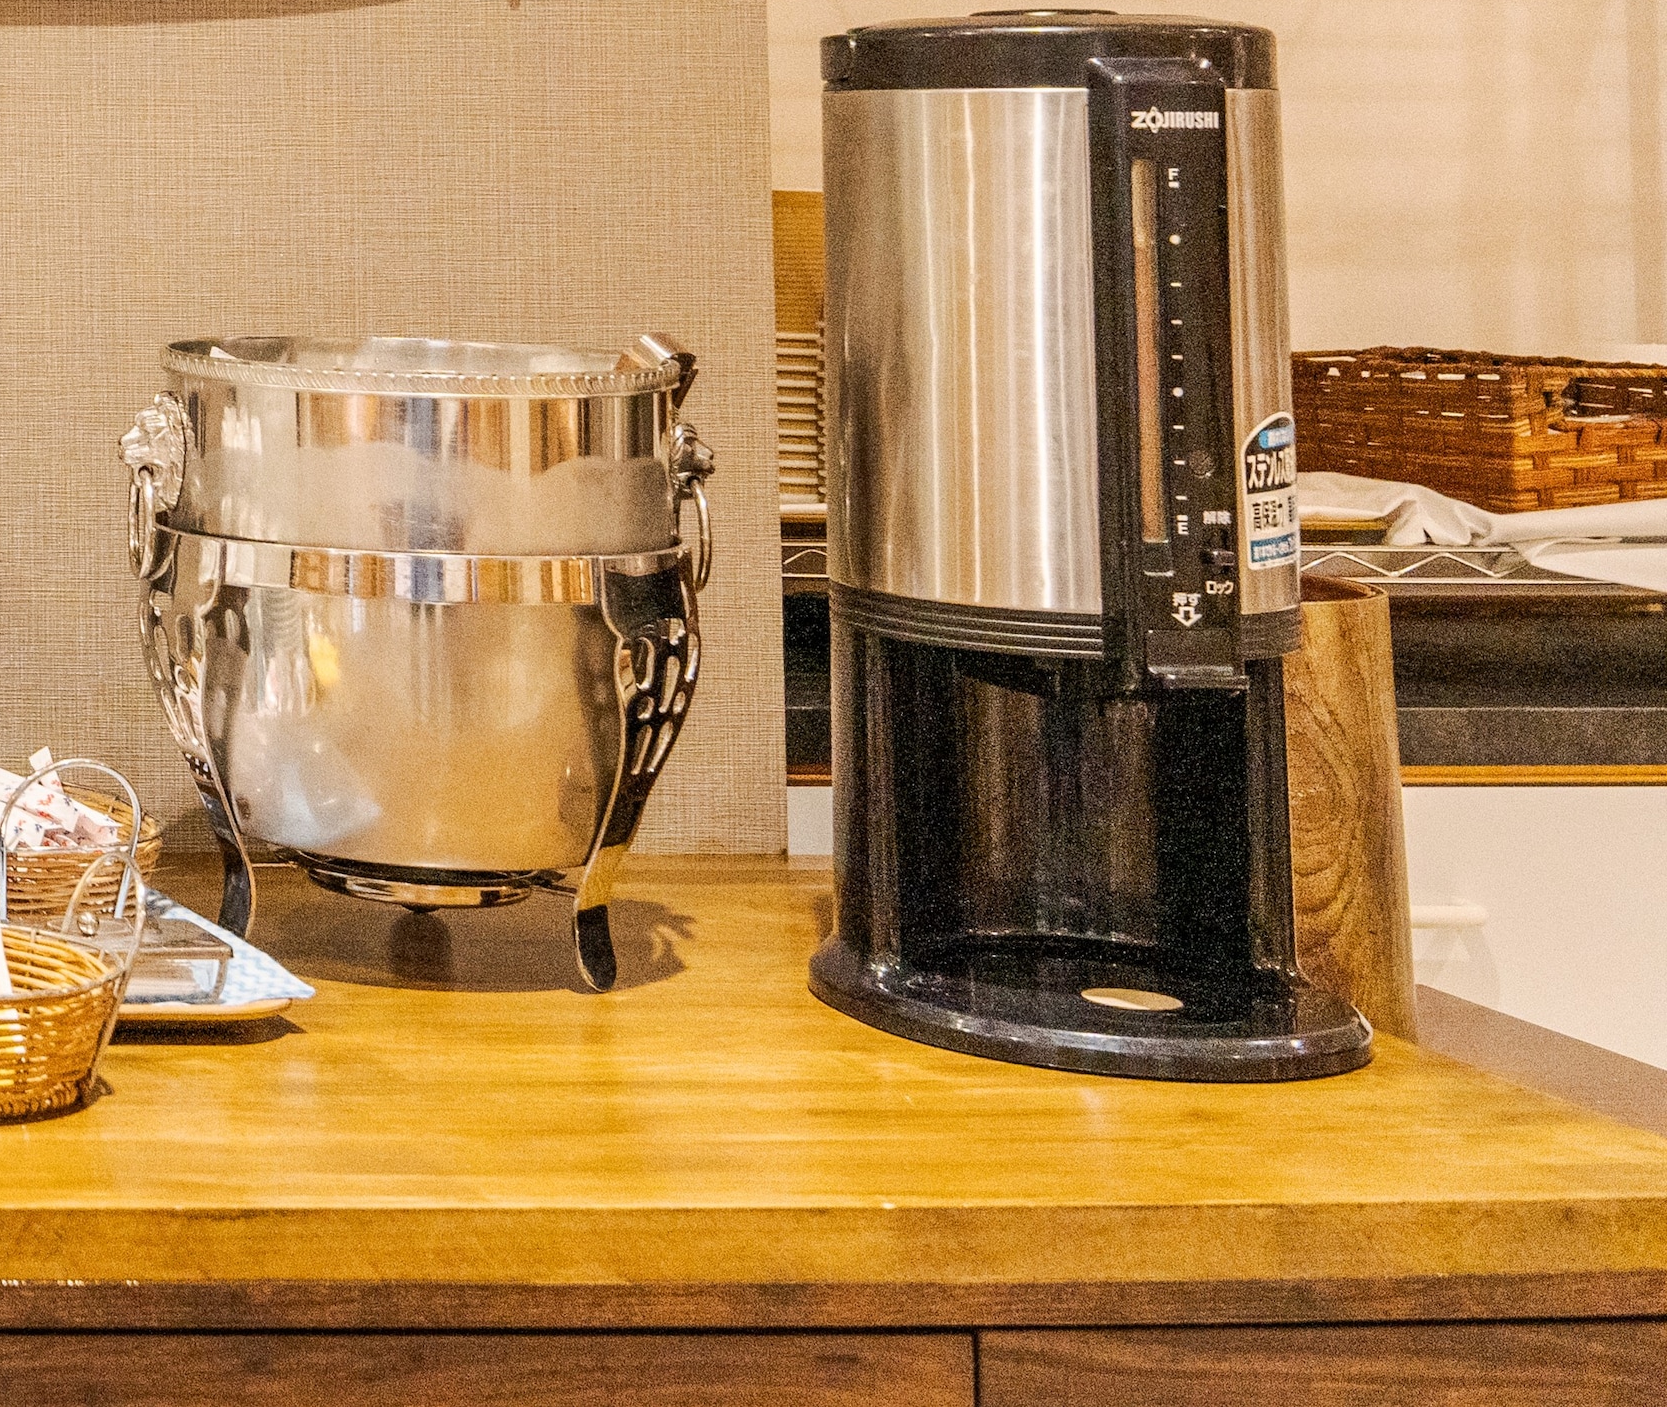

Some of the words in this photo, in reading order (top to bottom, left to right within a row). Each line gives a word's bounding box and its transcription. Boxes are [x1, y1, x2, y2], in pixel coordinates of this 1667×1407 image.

[1130, 105, 1220, 134] ZOJIRUSHI
[1168, 168, 1179, 181] F
[1177, 522, 1188, 535] E
[1205, 580, 1235, 595] ロック
